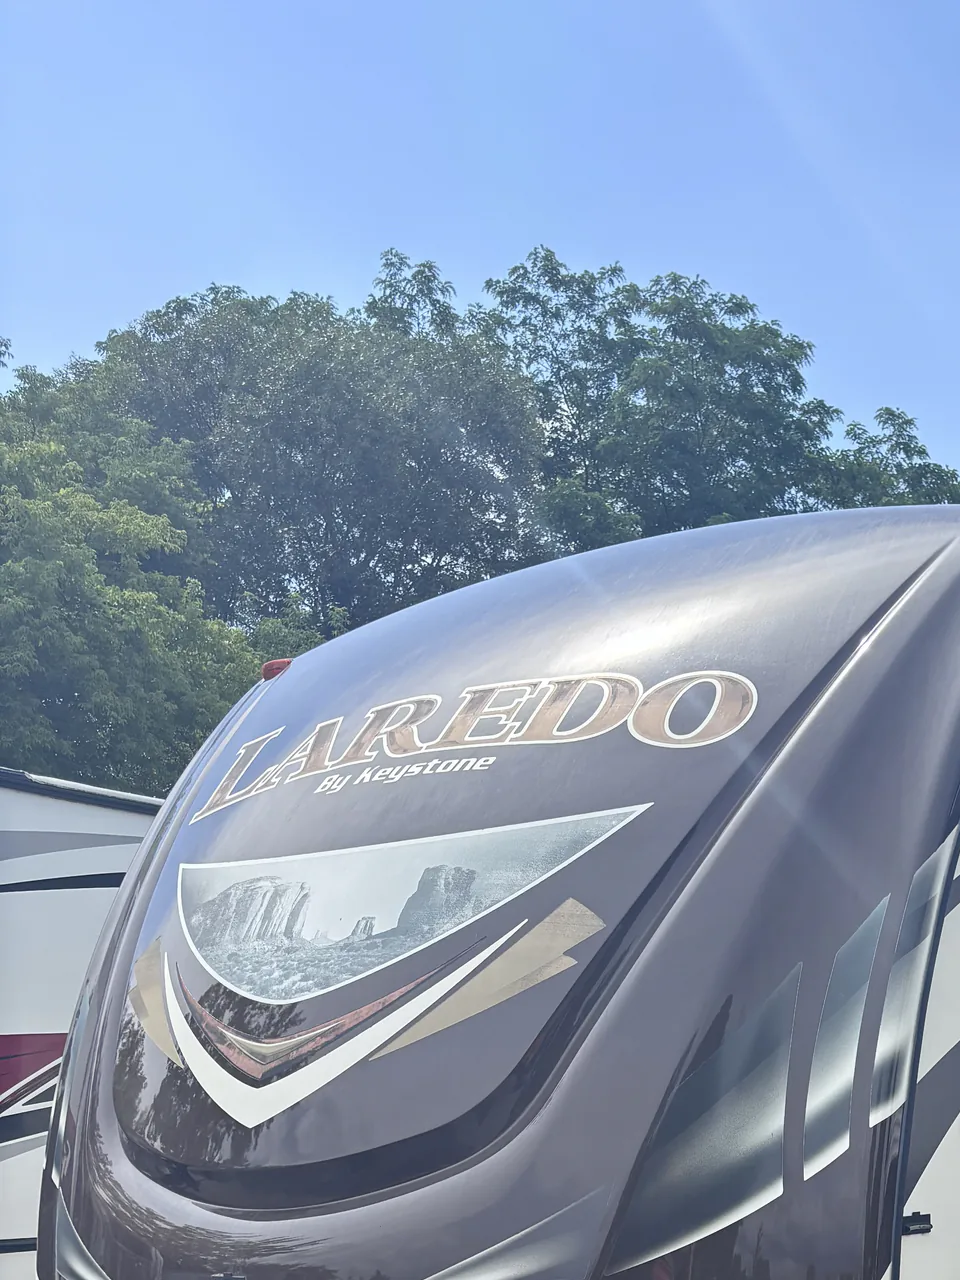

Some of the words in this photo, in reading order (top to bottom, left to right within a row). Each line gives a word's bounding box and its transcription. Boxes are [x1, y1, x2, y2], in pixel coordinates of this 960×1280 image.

[189, 670, 758, 825] LAREDO
[313, 773, 352, 795] By
[353, 756, 497, 784] Keystone
